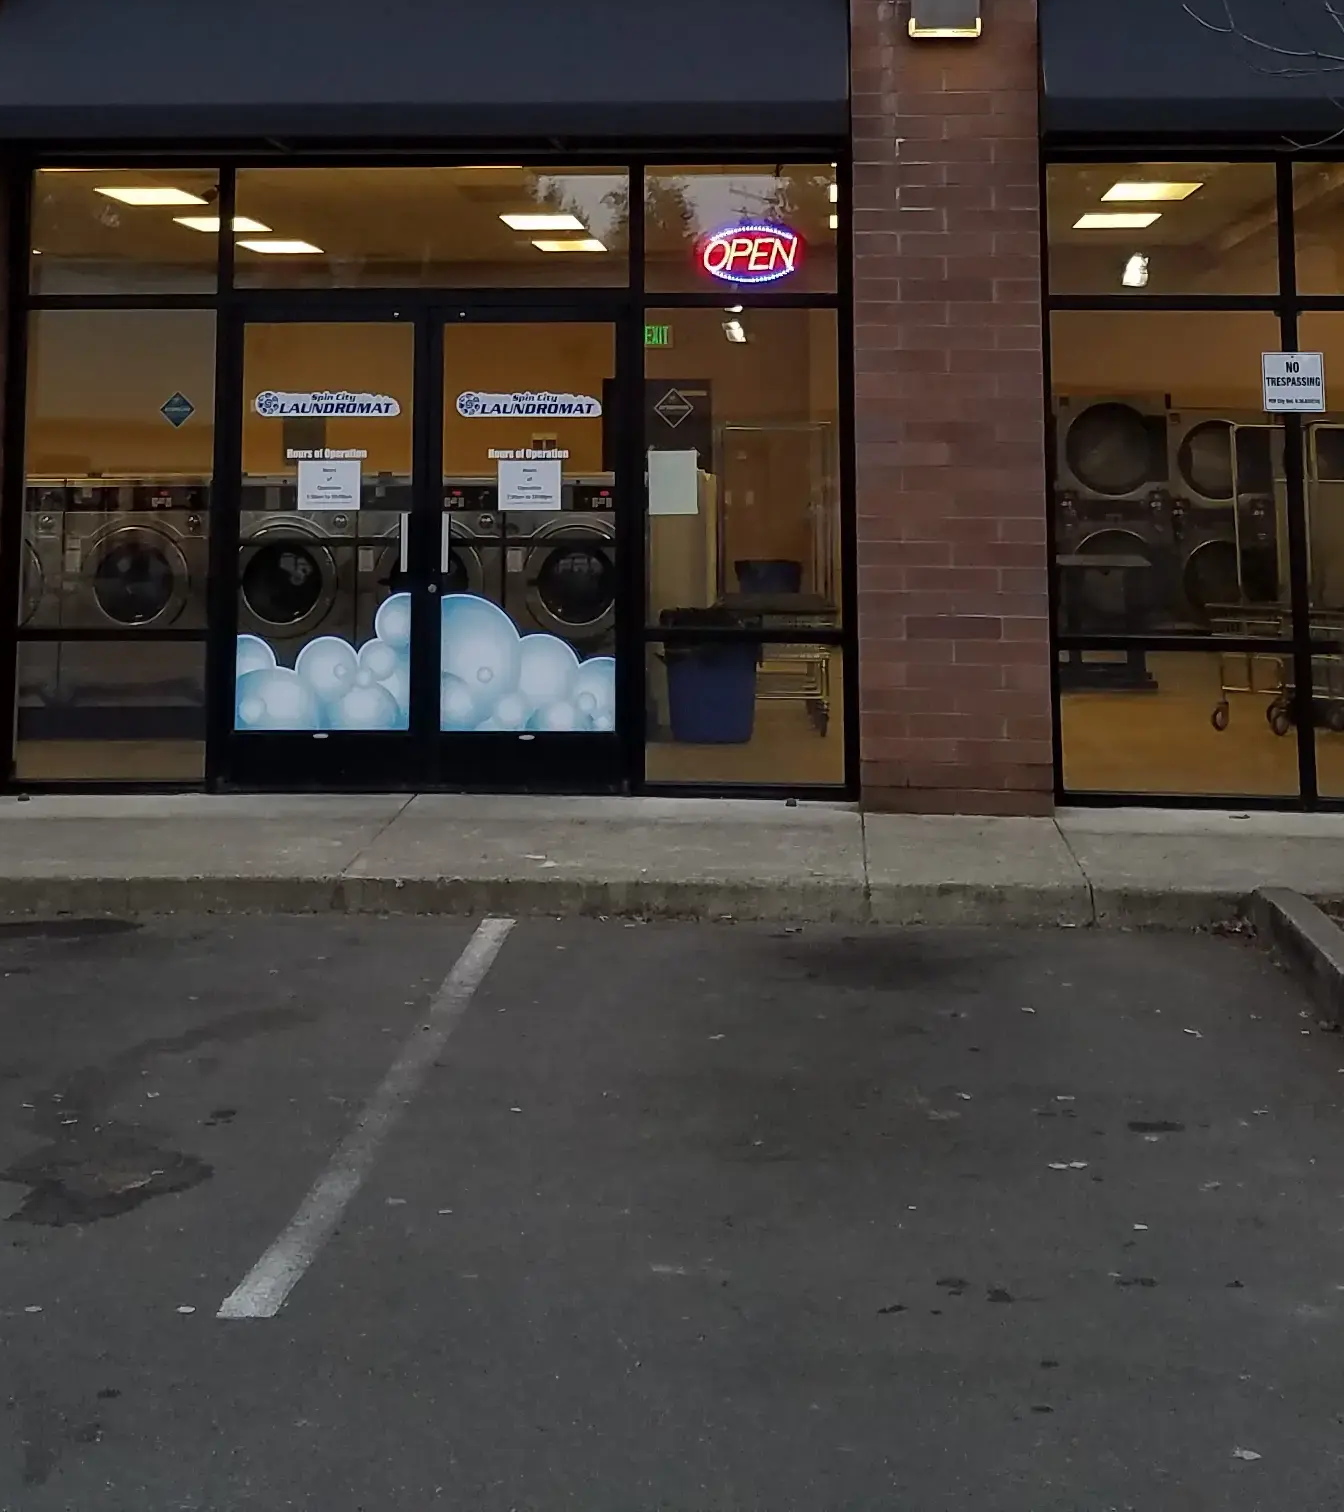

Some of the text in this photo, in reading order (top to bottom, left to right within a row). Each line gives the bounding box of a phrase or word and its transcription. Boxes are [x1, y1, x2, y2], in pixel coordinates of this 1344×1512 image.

[703, 237, 798, 271] OPEN
[645, 326, 669, 344] EXIT
[1286, 361, 1300, 373] NO
[1266, 376, 1321, 387] TRESPASSING
[312, 392, 357, 402] Spin City
[513, 393, 558, 403] Spin City
[279, 403, 394, 414] LAUNDROMAT
[480, 404, 595, 415] LAUNDROMAT
[286, 449, 368, 459] Hours of Operation
[488, 449, 569, 459] Hours of Operation
